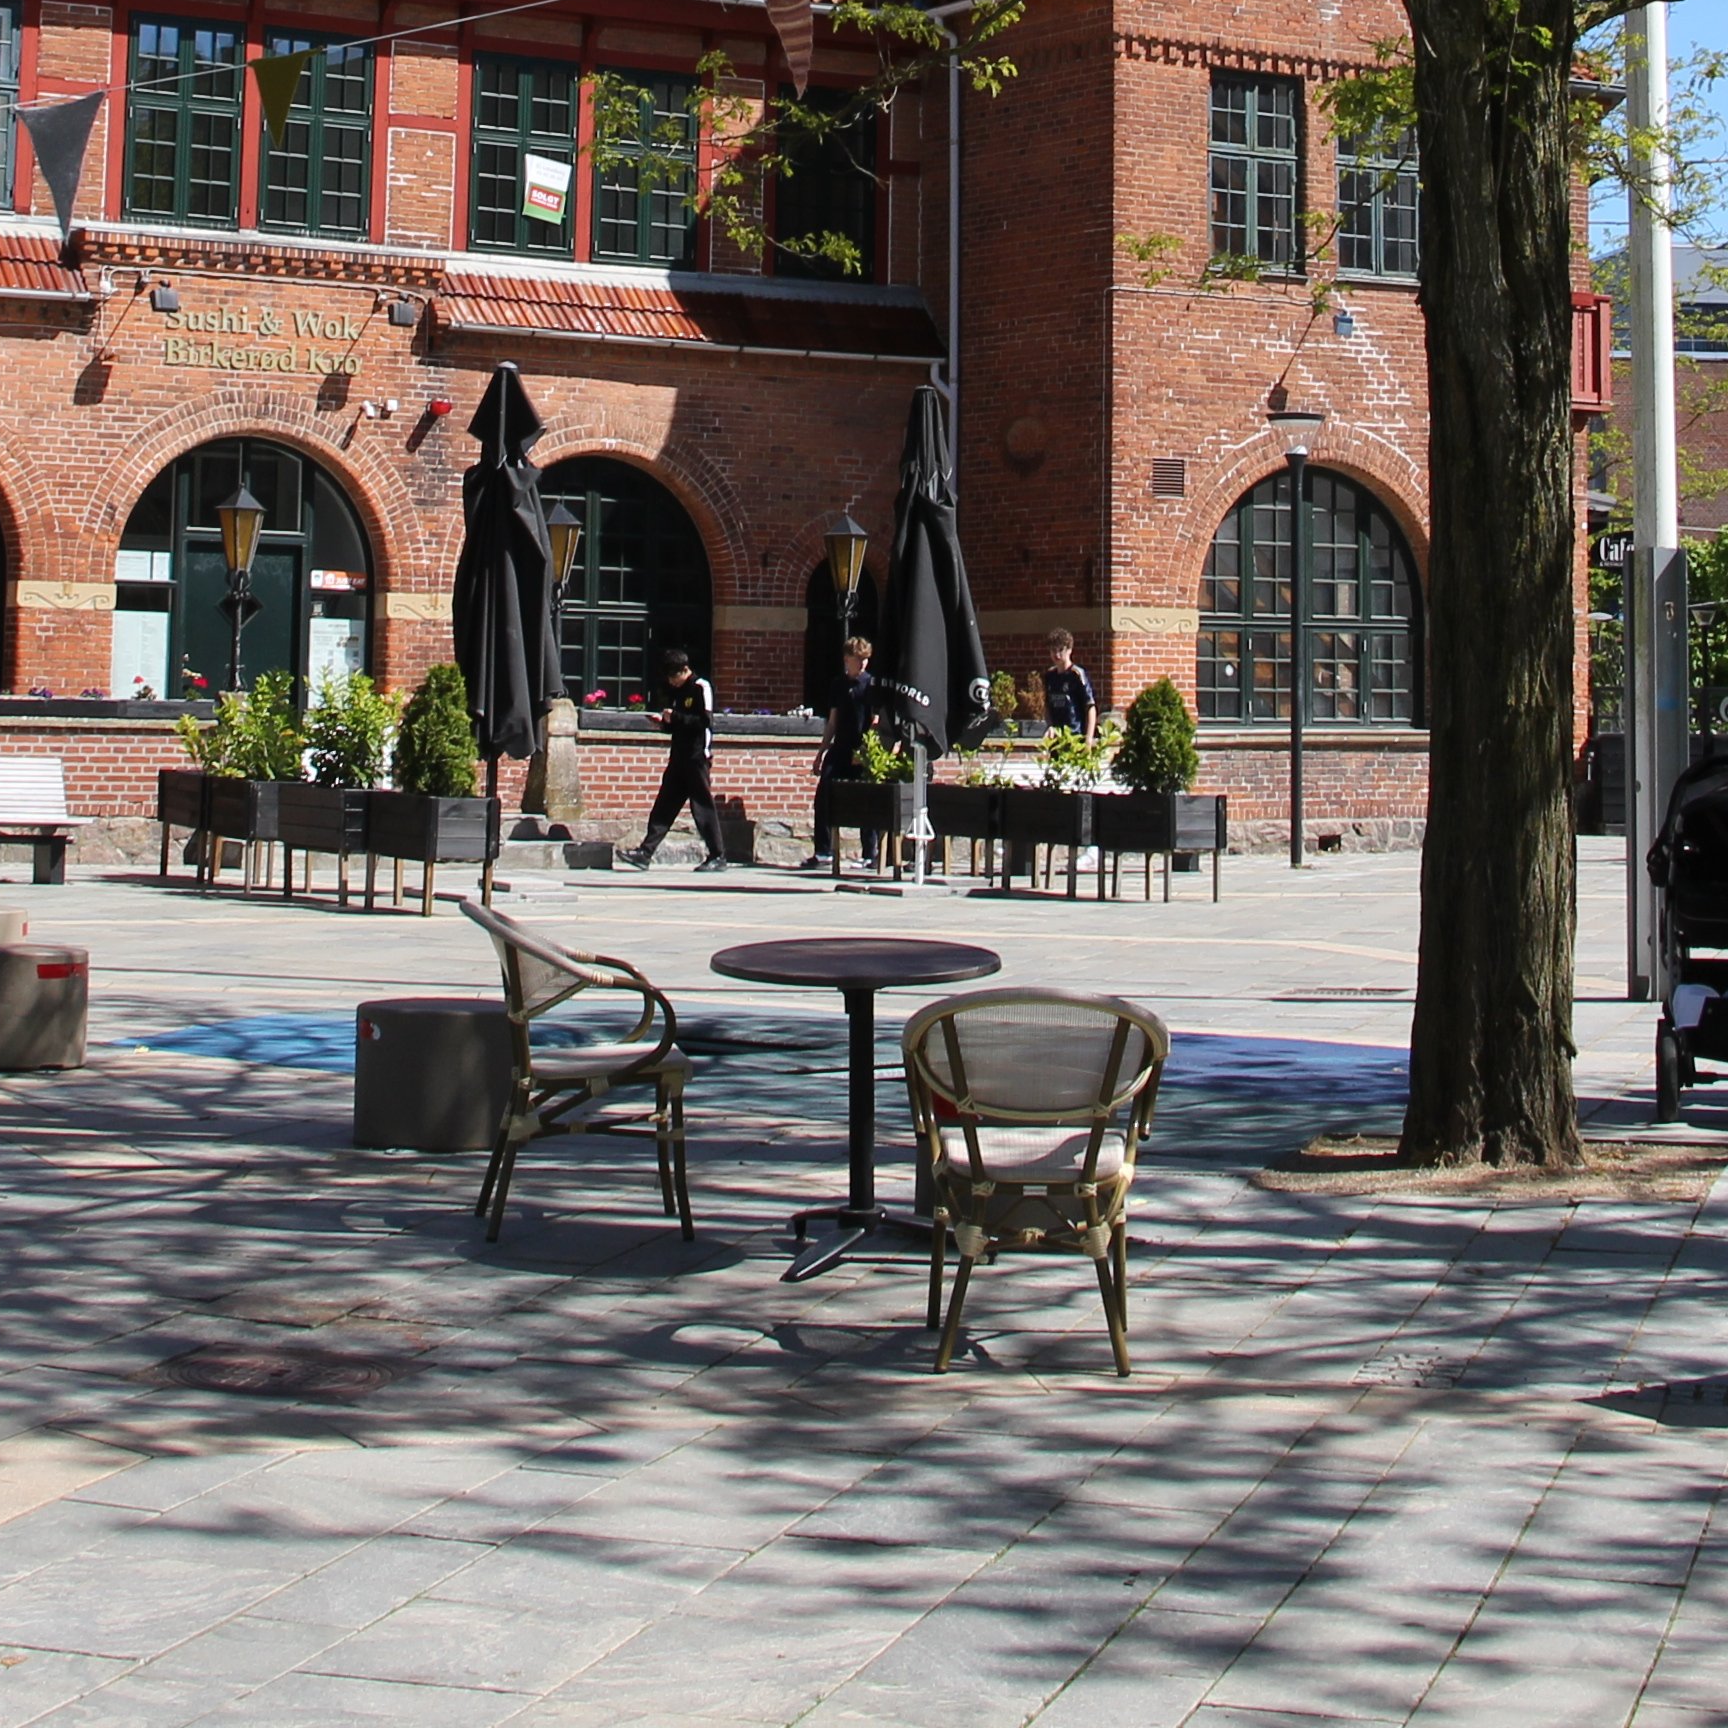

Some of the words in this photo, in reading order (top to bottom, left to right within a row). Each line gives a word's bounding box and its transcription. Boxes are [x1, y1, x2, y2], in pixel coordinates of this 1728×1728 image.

[532, 189, 560, 205] SOLGT
[165, 305, 249, 334] Sushi
[257, 305, 284, 336] &
[292, 310, 363, 341] Wok
[165, 337, 297, 372] Birkerød
[306, 346, 363, 376] Kro
